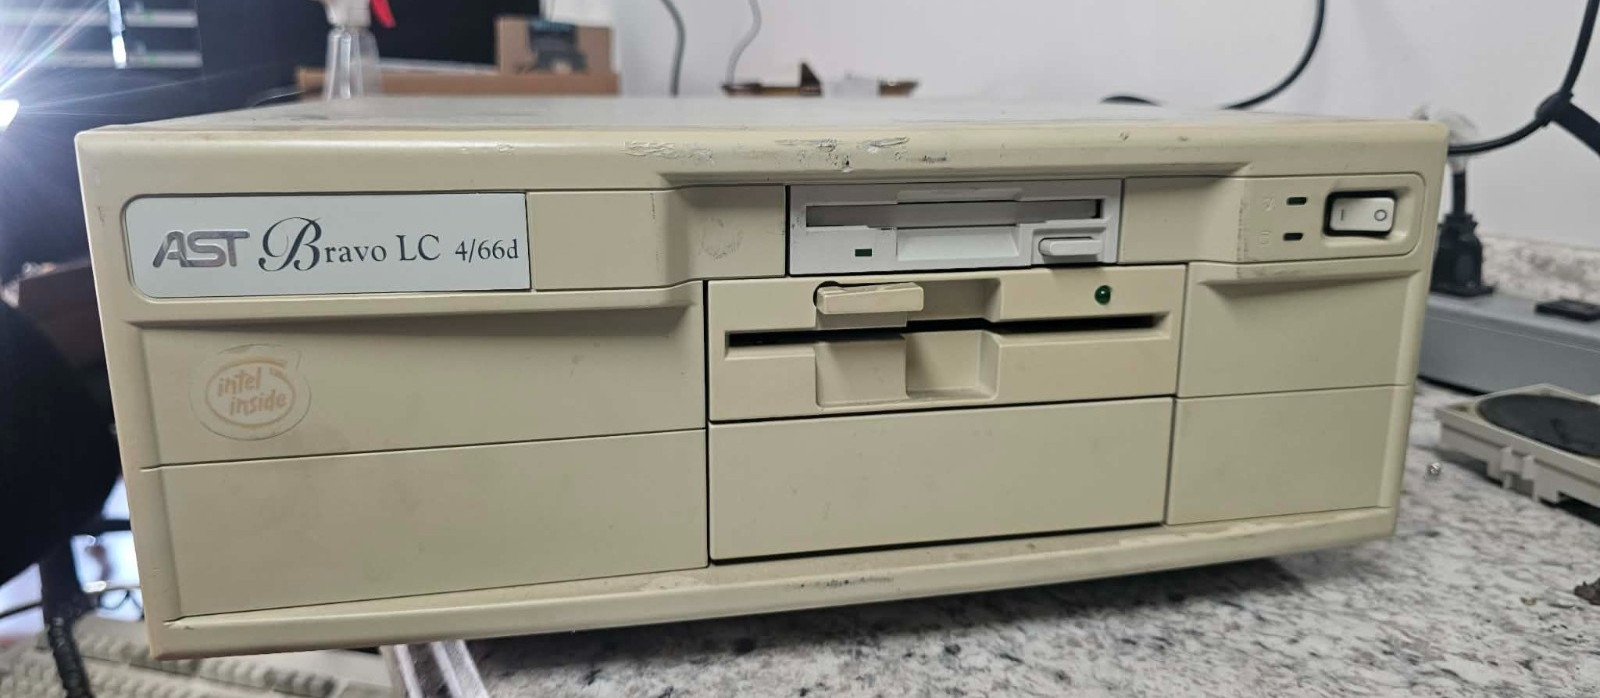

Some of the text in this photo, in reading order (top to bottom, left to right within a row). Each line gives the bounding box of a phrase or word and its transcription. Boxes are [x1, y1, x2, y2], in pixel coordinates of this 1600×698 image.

[152, 216, 519, 272] AST Bravo LC 4/66d
[217, 366, 262, 397] intel
[229, 389, 288, 416] inside
